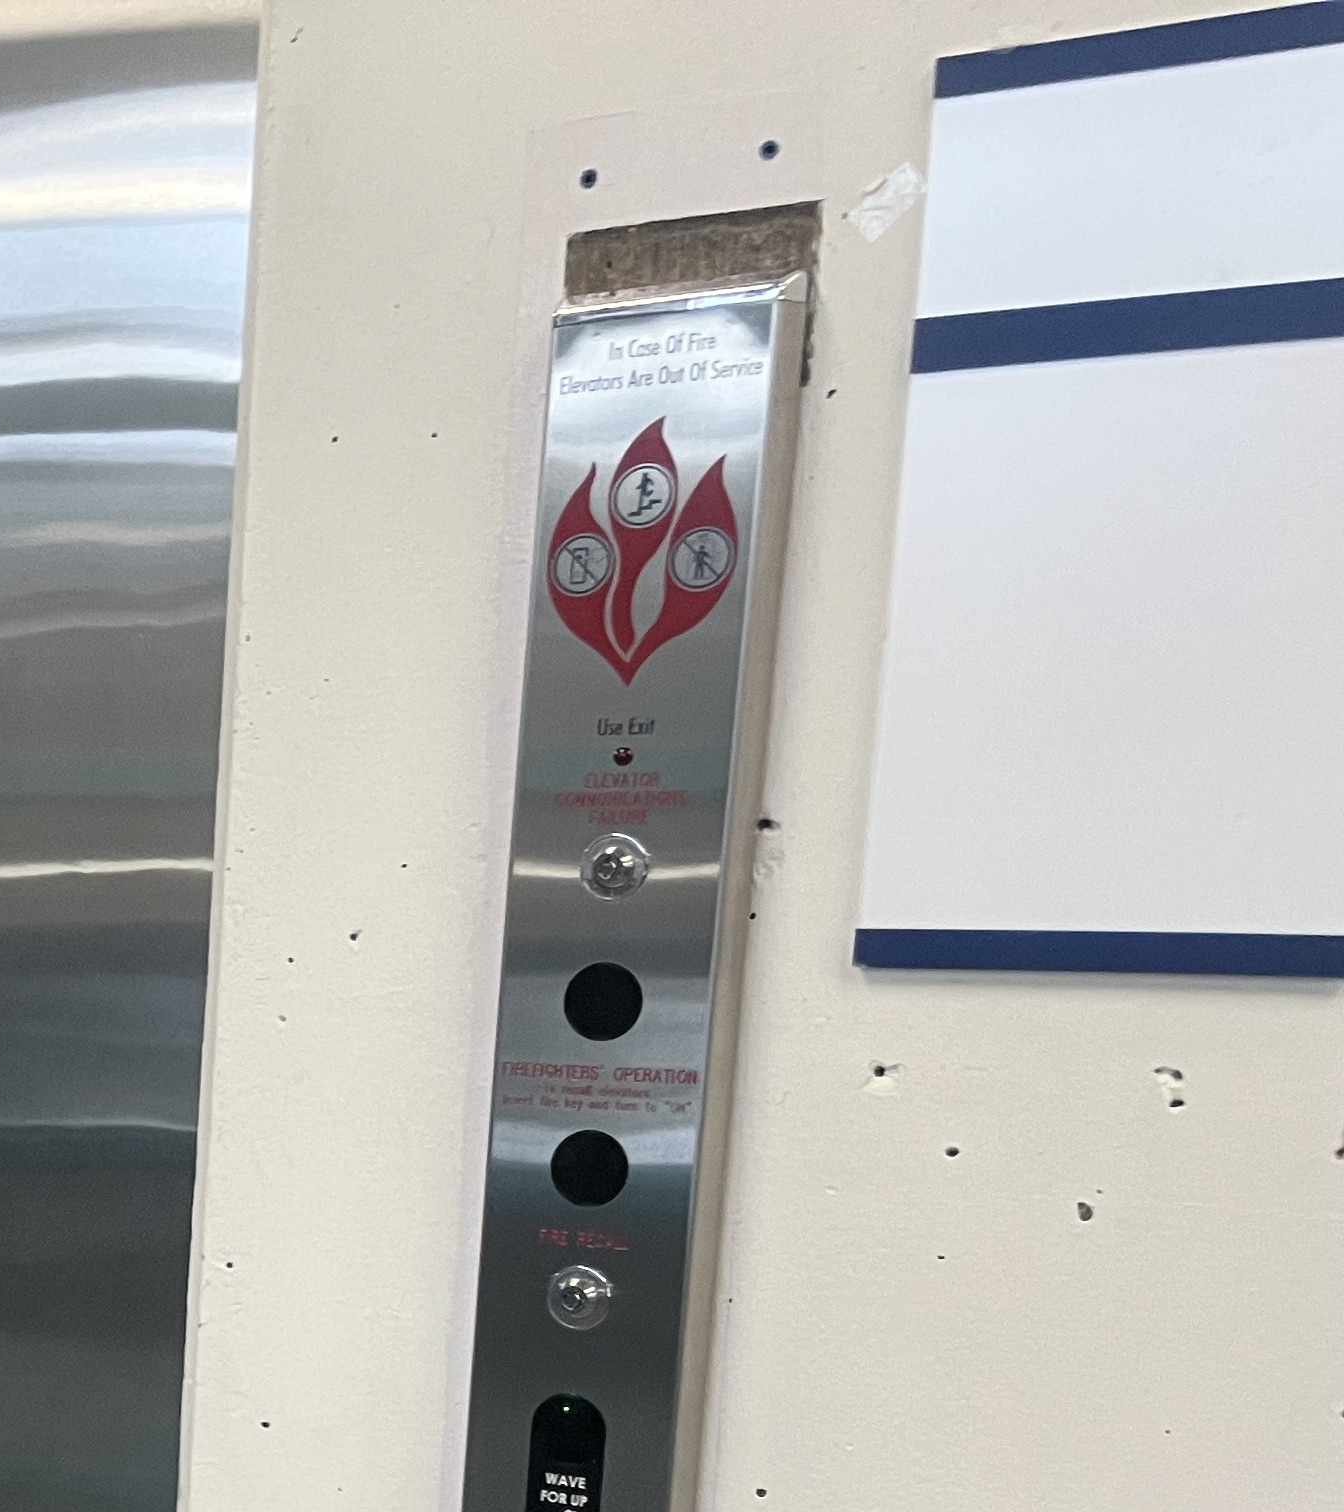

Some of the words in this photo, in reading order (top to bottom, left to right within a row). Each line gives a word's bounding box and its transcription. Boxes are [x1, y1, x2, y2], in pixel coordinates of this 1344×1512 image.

[609, 340, 624, 361] In
[628, 337, 660, 359] Case
[666, 333, 686, 354] Of
[689, 331, 717, 352] Fire
[559, 373, 624, 396] Elevators
[627, 369, 654, 389] Are
[658, 365, 685, 385] Out
[690, 361, 708, 382] Of
[711, 357, 764, 381] Service
[597, 718, 623, 737] Use
[628, 717, 655, 735] Exit
[613, 1066, 698, 1085] OPERATION
[544, 1472, 586, 1490] WAVE
[539, 1489, 567, 1505] FOR
[570, 1494, 588, 1508] UP
